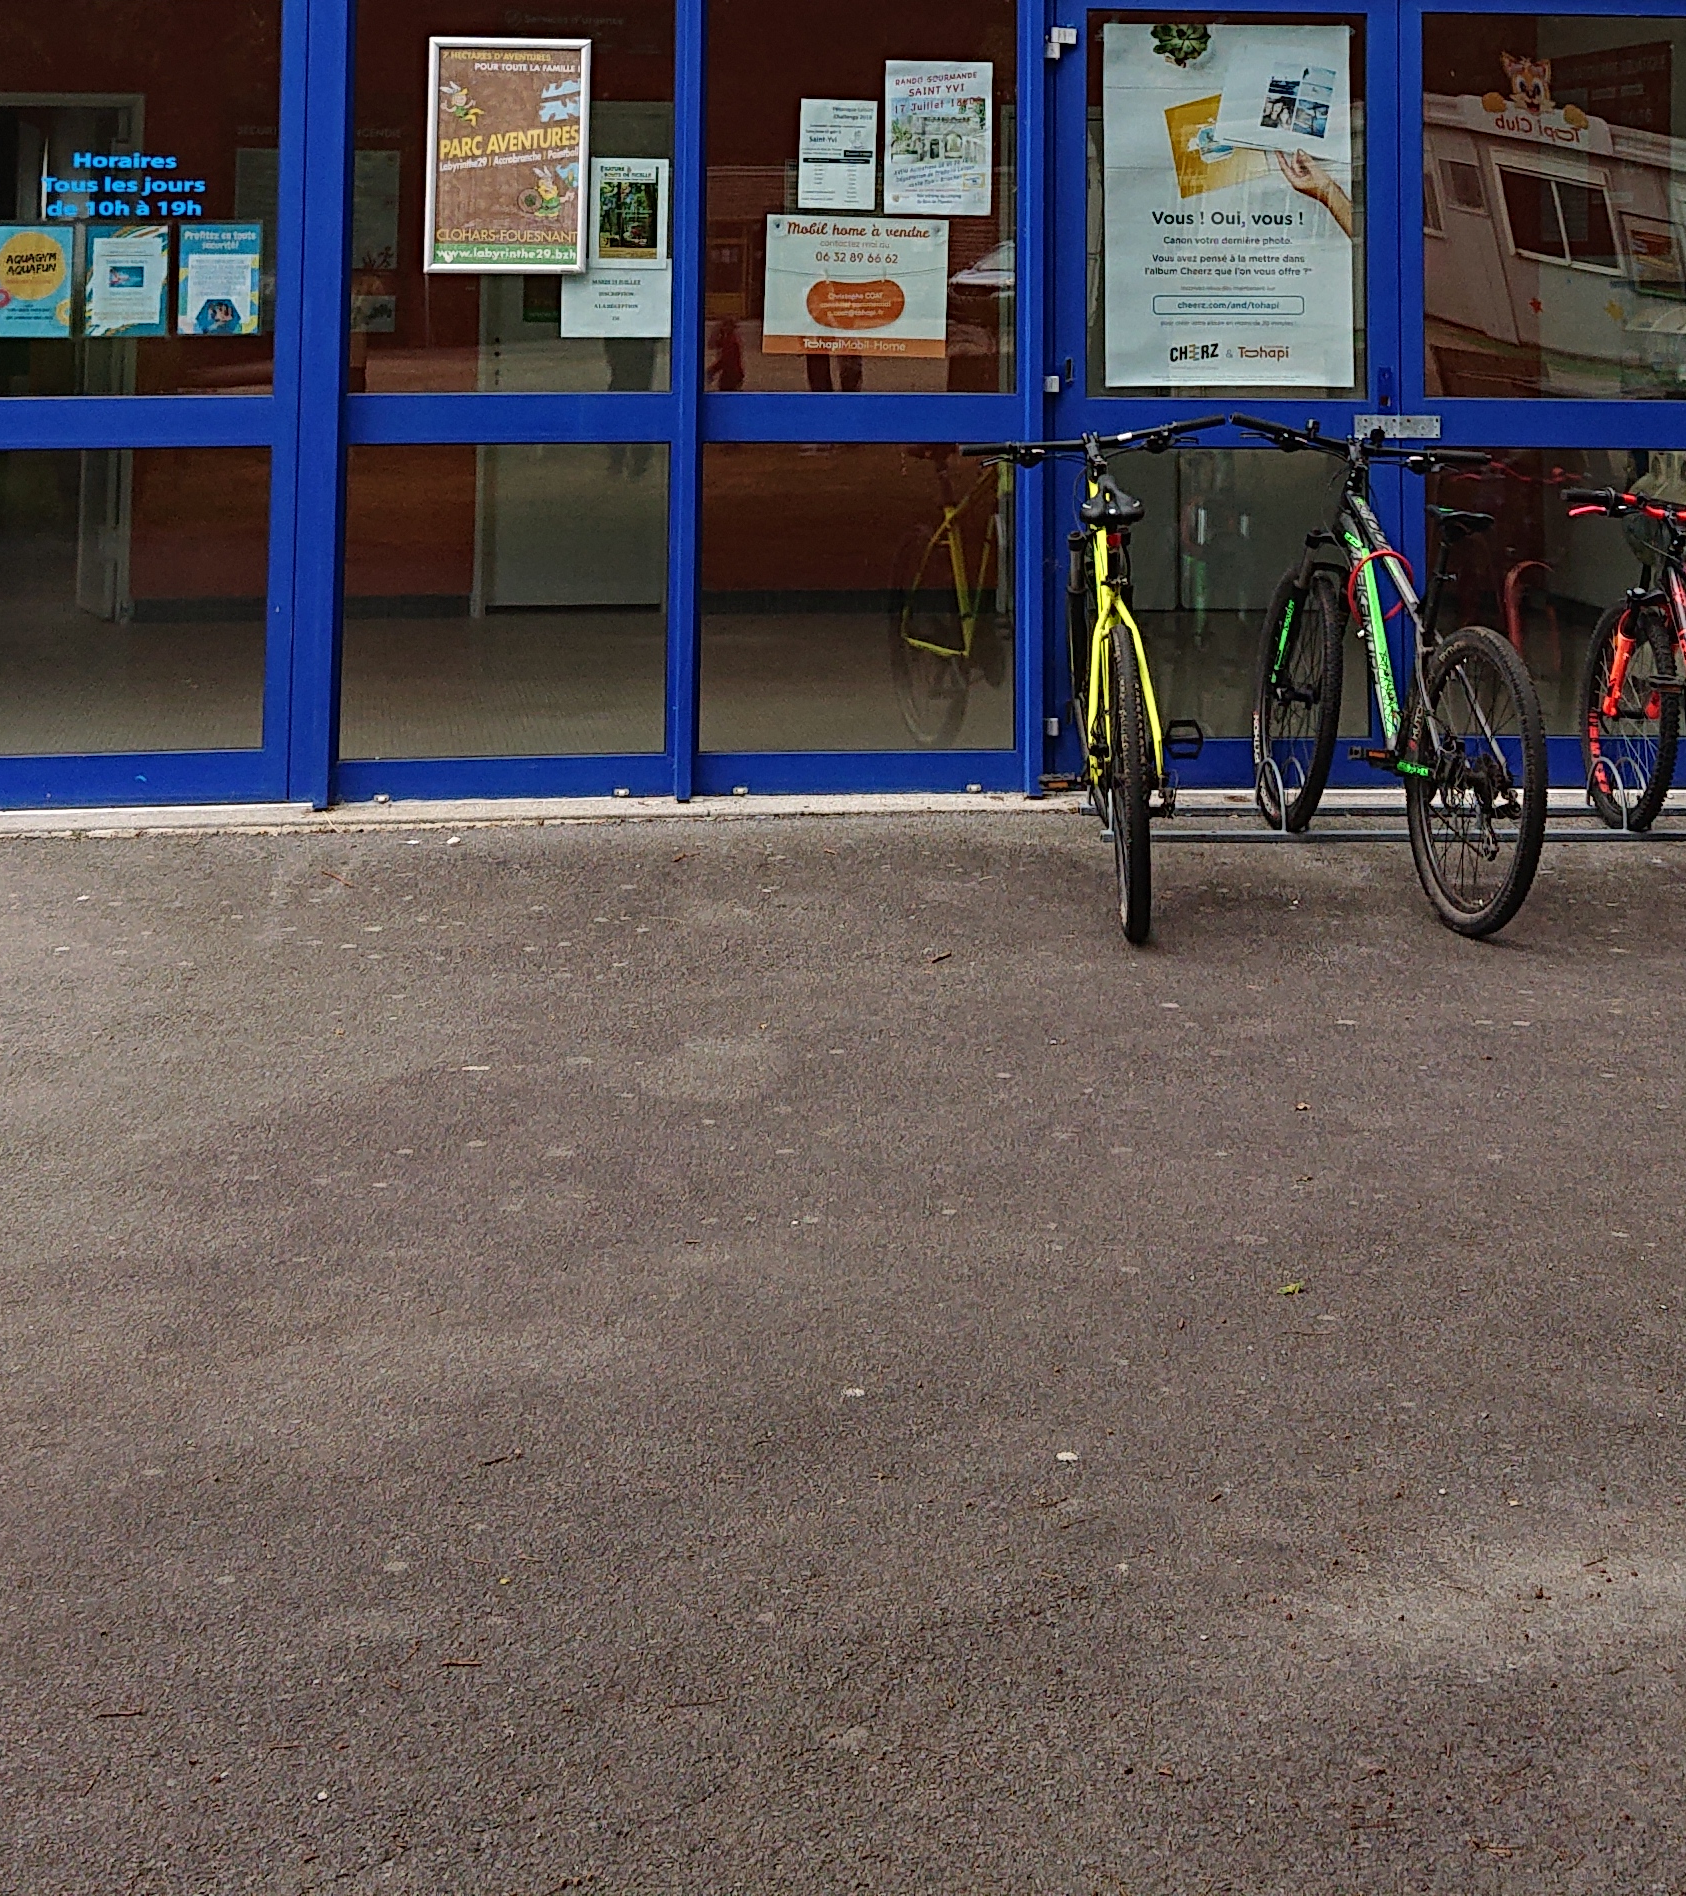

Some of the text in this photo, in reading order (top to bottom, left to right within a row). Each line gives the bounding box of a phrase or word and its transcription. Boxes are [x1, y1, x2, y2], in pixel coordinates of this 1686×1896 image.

[475, 62, 499, 72] POUR
[501, 63, 528, 72] TOUTE
[530, 64, 541, 72] LA
[542, 64, 577, 73] FAMILLE
[895, 71, 977, 86] RANDO GOURMANDE
[909, 83, 965, 97] SAINT YVI
[895, 104, 905, 114] 17
[911, 99, 944, 112] Juillet
[439, 125, 580, 160] PARC AVENTURES
[73, 152, 177, 169] Horaires
[41, 176, 206, 197] Tous les jours
[47, 200, 203, 216] de 10h à 19h
[1152, 211, 1303, 228] Vous ! Oui, vous !
[787, 221, 930, 239] Mobil home à vendre
[819, 239, 860, 248] contactez
[1163, 235, 1293, 247] Canon votre dernière photo.
[6, 252, 57, 265] AQUAGYM
[437, 247, 577, 261] www.labyrinthe29.bzh
[815, 251, 898, 264] 06 32 89 66 62
[1152, 254, 1305, 265] Vous avez pensé à la mettre dans
[6, 264, 57, 276] AQUAFUN
[1144, 267, 1178, 276] l'album
[1180, 267, 1213, 276] Cheerz
[1214, 268, 1233, 278] que
[1253, 268, 1277, 276] vous
[1278, 267, 1301, 276] offre
[1177, 301, 1280, 311] cheerz.com/and/tohapi
[1225, 349, 1234, 359] &
